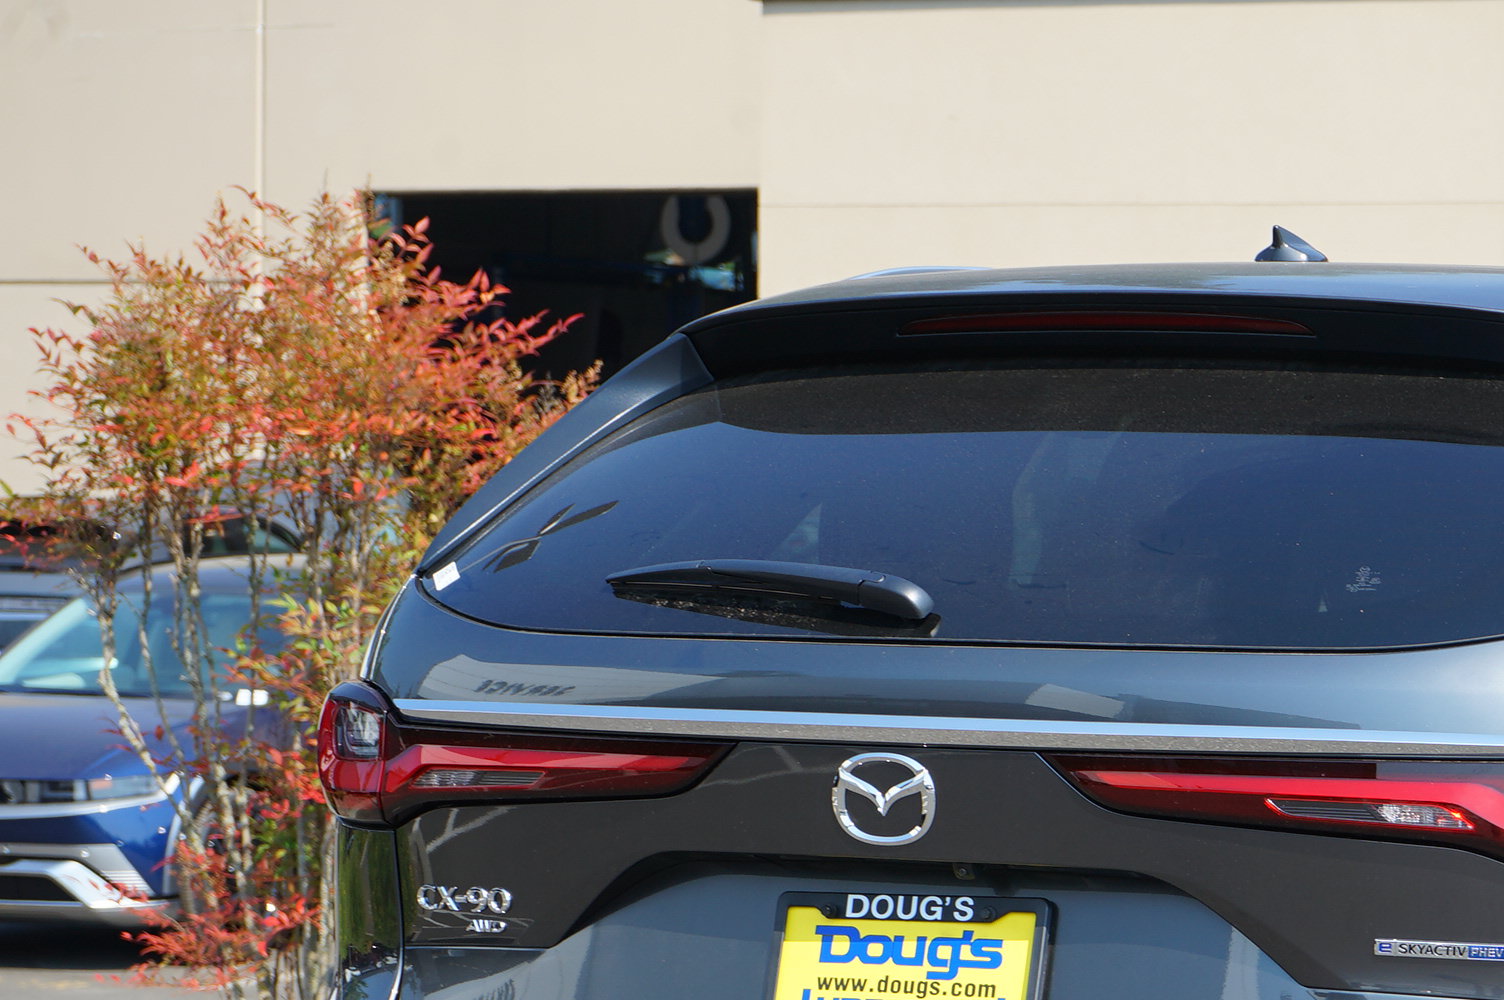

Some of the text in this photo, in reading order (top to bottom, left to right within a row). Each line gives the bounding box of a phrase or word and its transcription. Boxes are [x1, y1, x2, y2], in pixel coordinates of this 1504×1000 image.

[416, 884, 513, 914] CX-90
[845, 894, 975, 921] DOUG'S
[466, 919, 508, 933] AWD
[815, 925, 1004, 980] Doug's
[1398, 943, 1467, 957] SKYACTIV
[1470, 946, 1504, 958] PHEV
[817, 976, 997, 999] www.dougs.com
